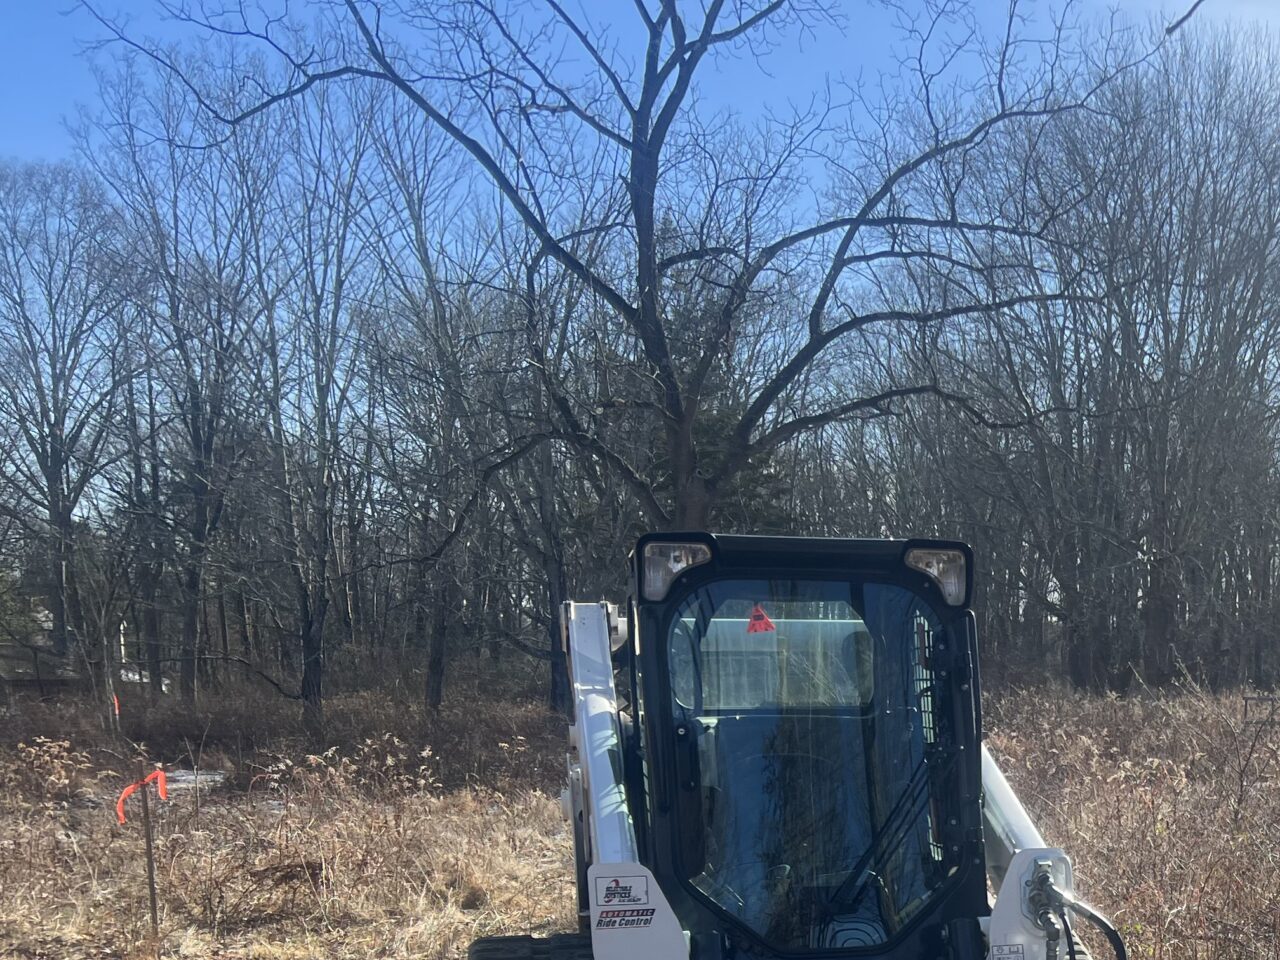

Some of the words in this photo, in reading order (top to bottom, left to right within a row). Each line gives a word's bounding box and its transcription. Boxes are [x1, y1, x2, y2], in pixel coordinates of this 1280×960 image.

[601, 909, 655, 917] AUTOMATIC
[596, 918, 617, 927] Ride
[618, 917, 653, 927] Control
